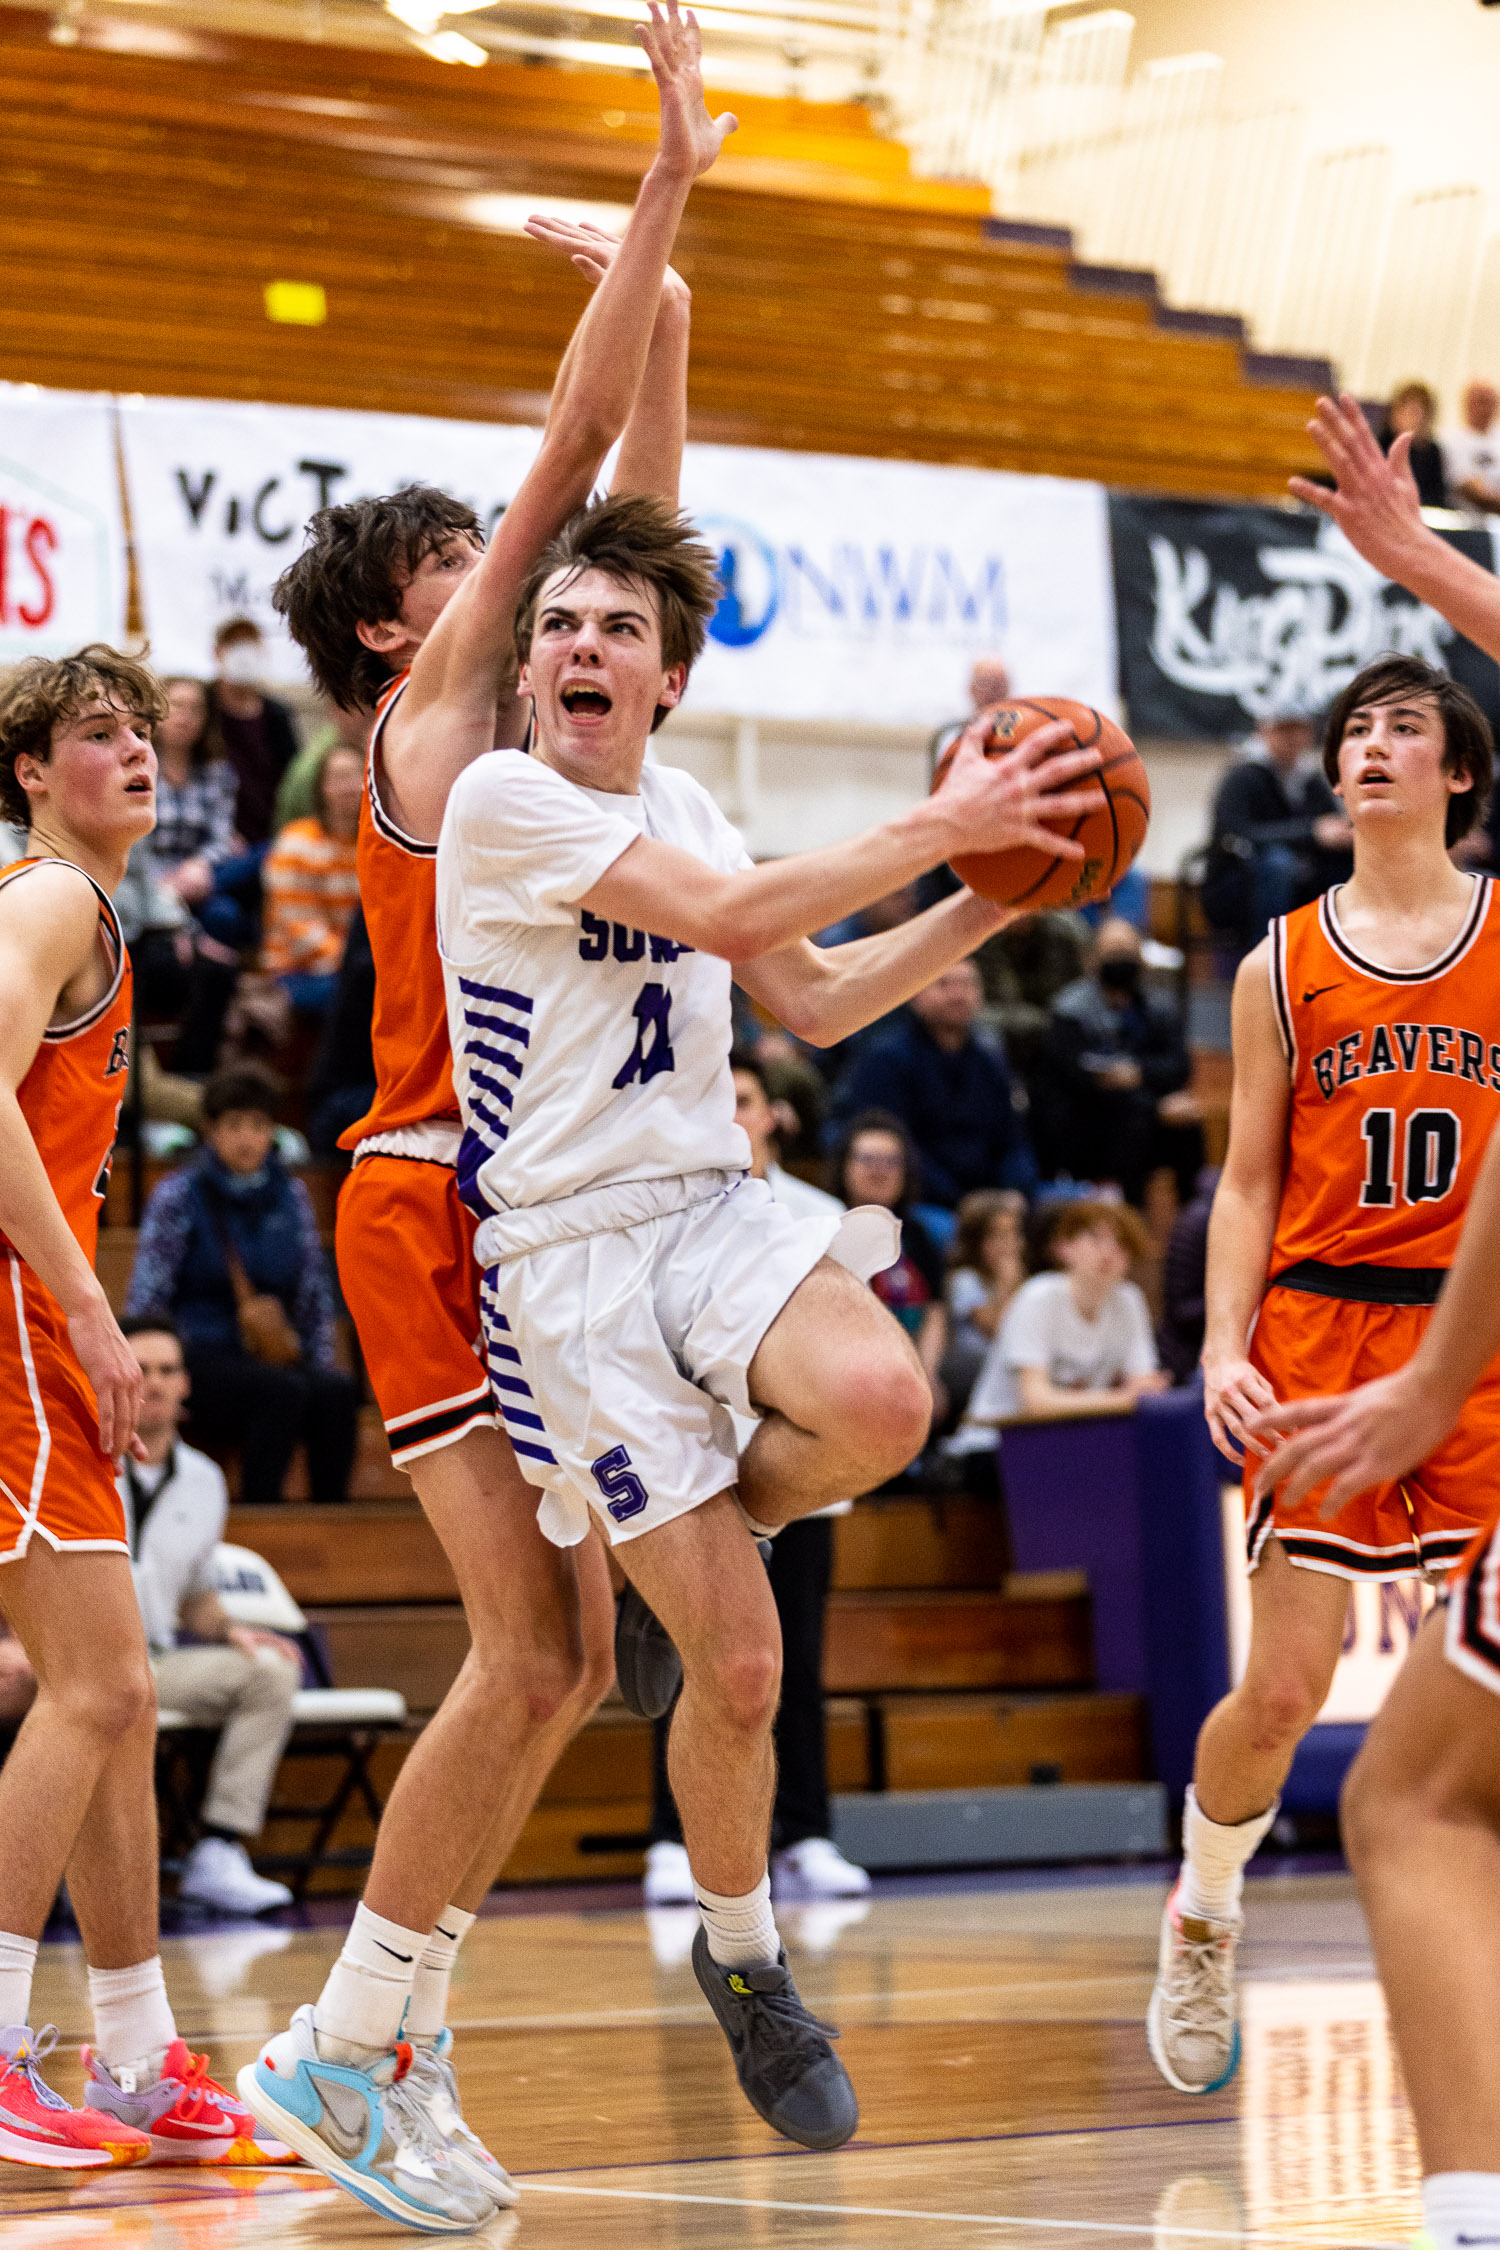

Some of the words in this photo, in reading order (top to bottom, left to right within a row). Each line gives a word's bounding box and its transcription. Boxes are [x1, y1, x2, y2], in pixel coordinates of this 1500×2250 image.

[0, 508, 57, 626] S
[784, 544, 1007, 626] NWM
[1358, 1107, 1462, 1209] 10
[590, 1443, 649, 1523] S
